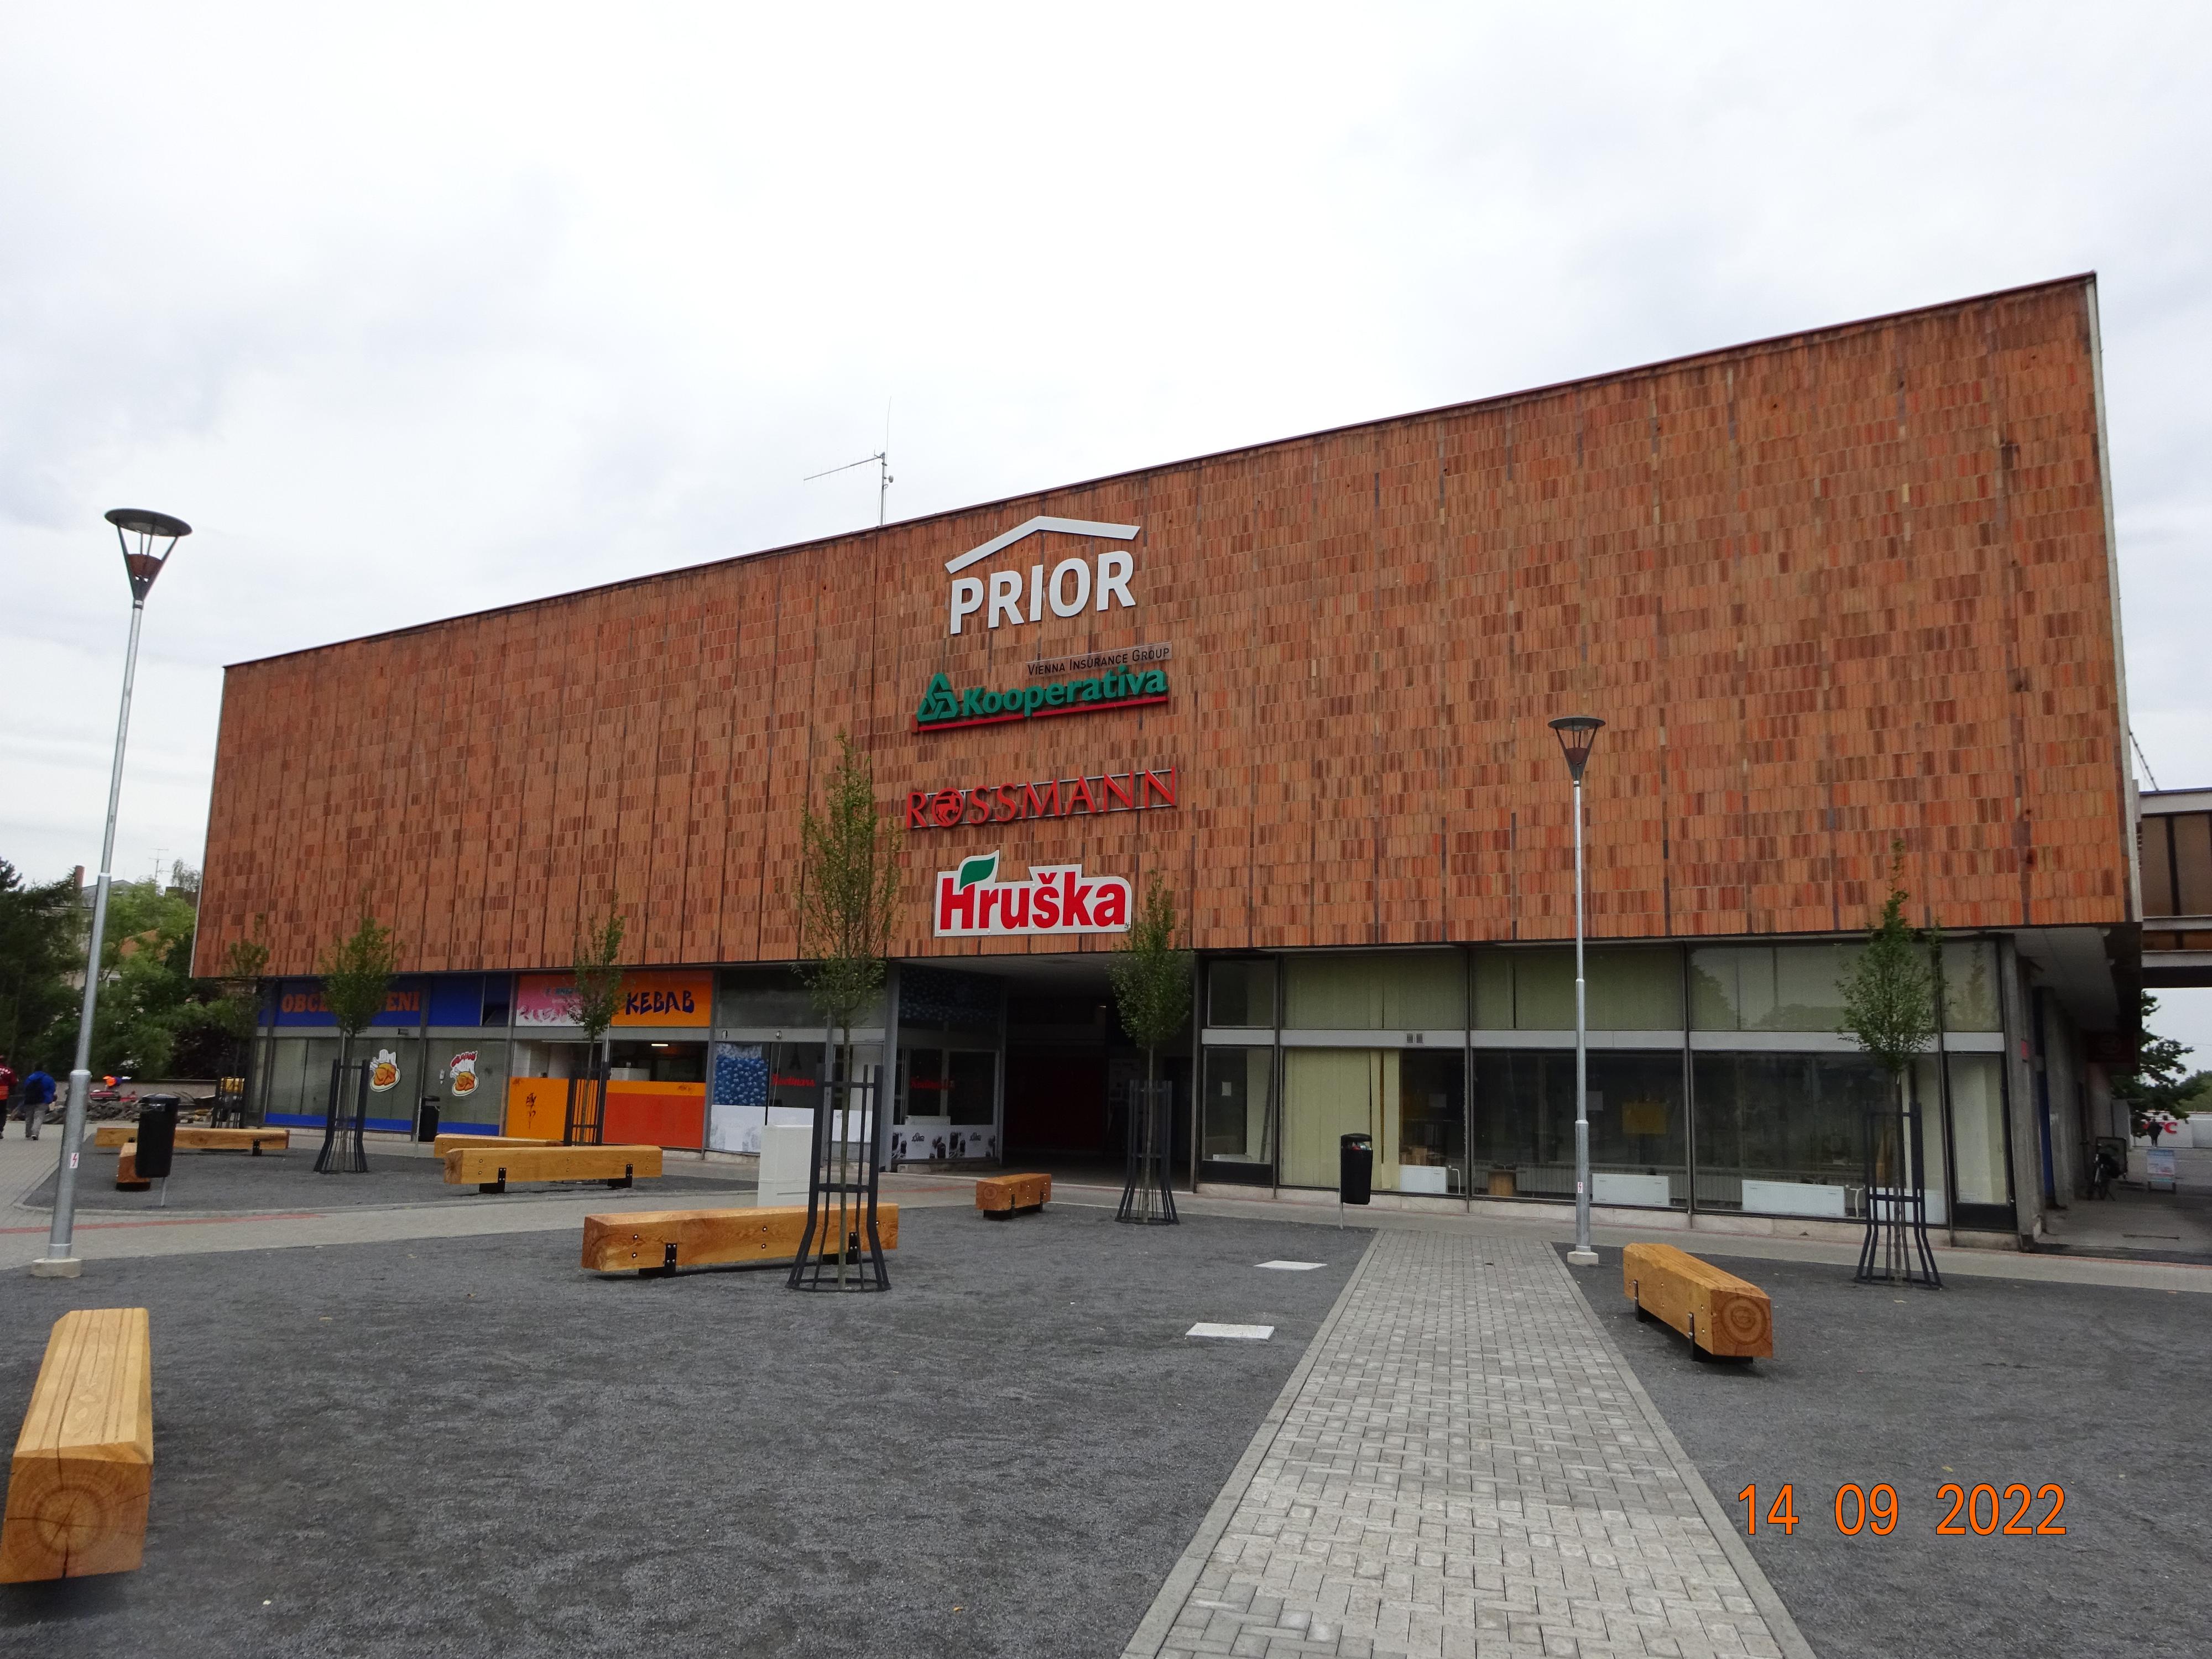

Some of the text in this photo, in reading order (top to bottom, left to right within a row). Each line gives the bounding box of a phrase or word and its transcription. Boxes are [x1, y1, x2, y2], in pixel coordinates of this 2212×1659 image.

[950, 550, 1136, 634] PRIOR
[963, 665, 1168, 718] Kooperativa
[906, 766, 1176, 829] ROSSMANN
[940, 872, 1126, 931] Hruška
[625, 990, 695, 1015] KEBAB
